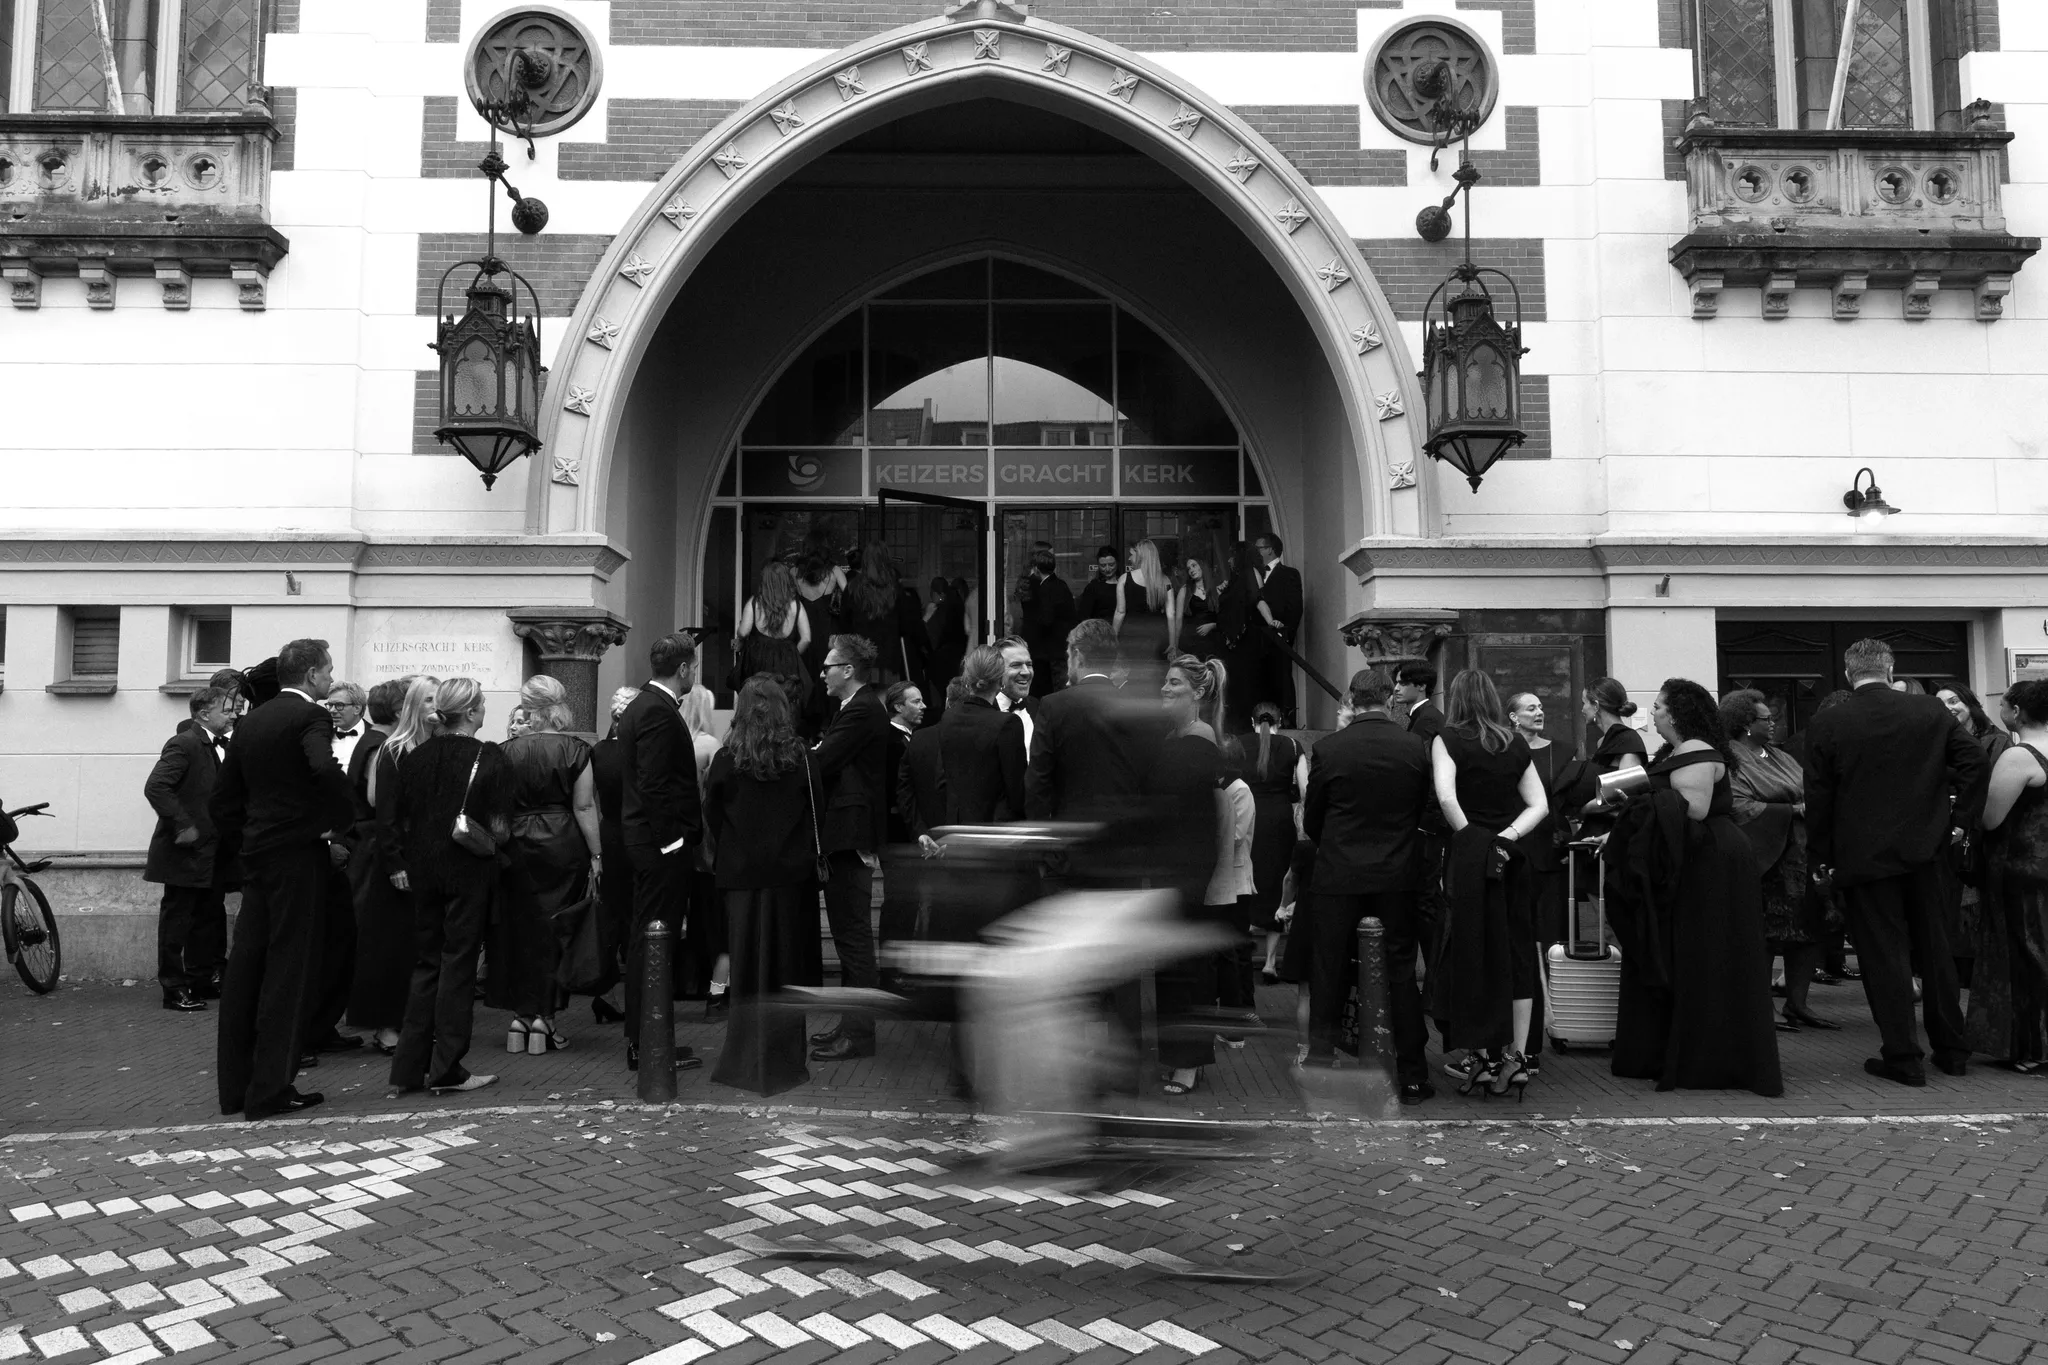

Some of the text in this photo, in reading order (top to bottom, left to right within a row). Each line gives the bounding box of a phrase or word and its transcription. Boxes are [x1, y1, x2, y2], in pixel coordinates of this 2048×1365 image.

[875, 464, 1195, 484] KEIZERS GRACHT KERK
[373, 642, 493, 653] KEIZERSGRACHT KERK
